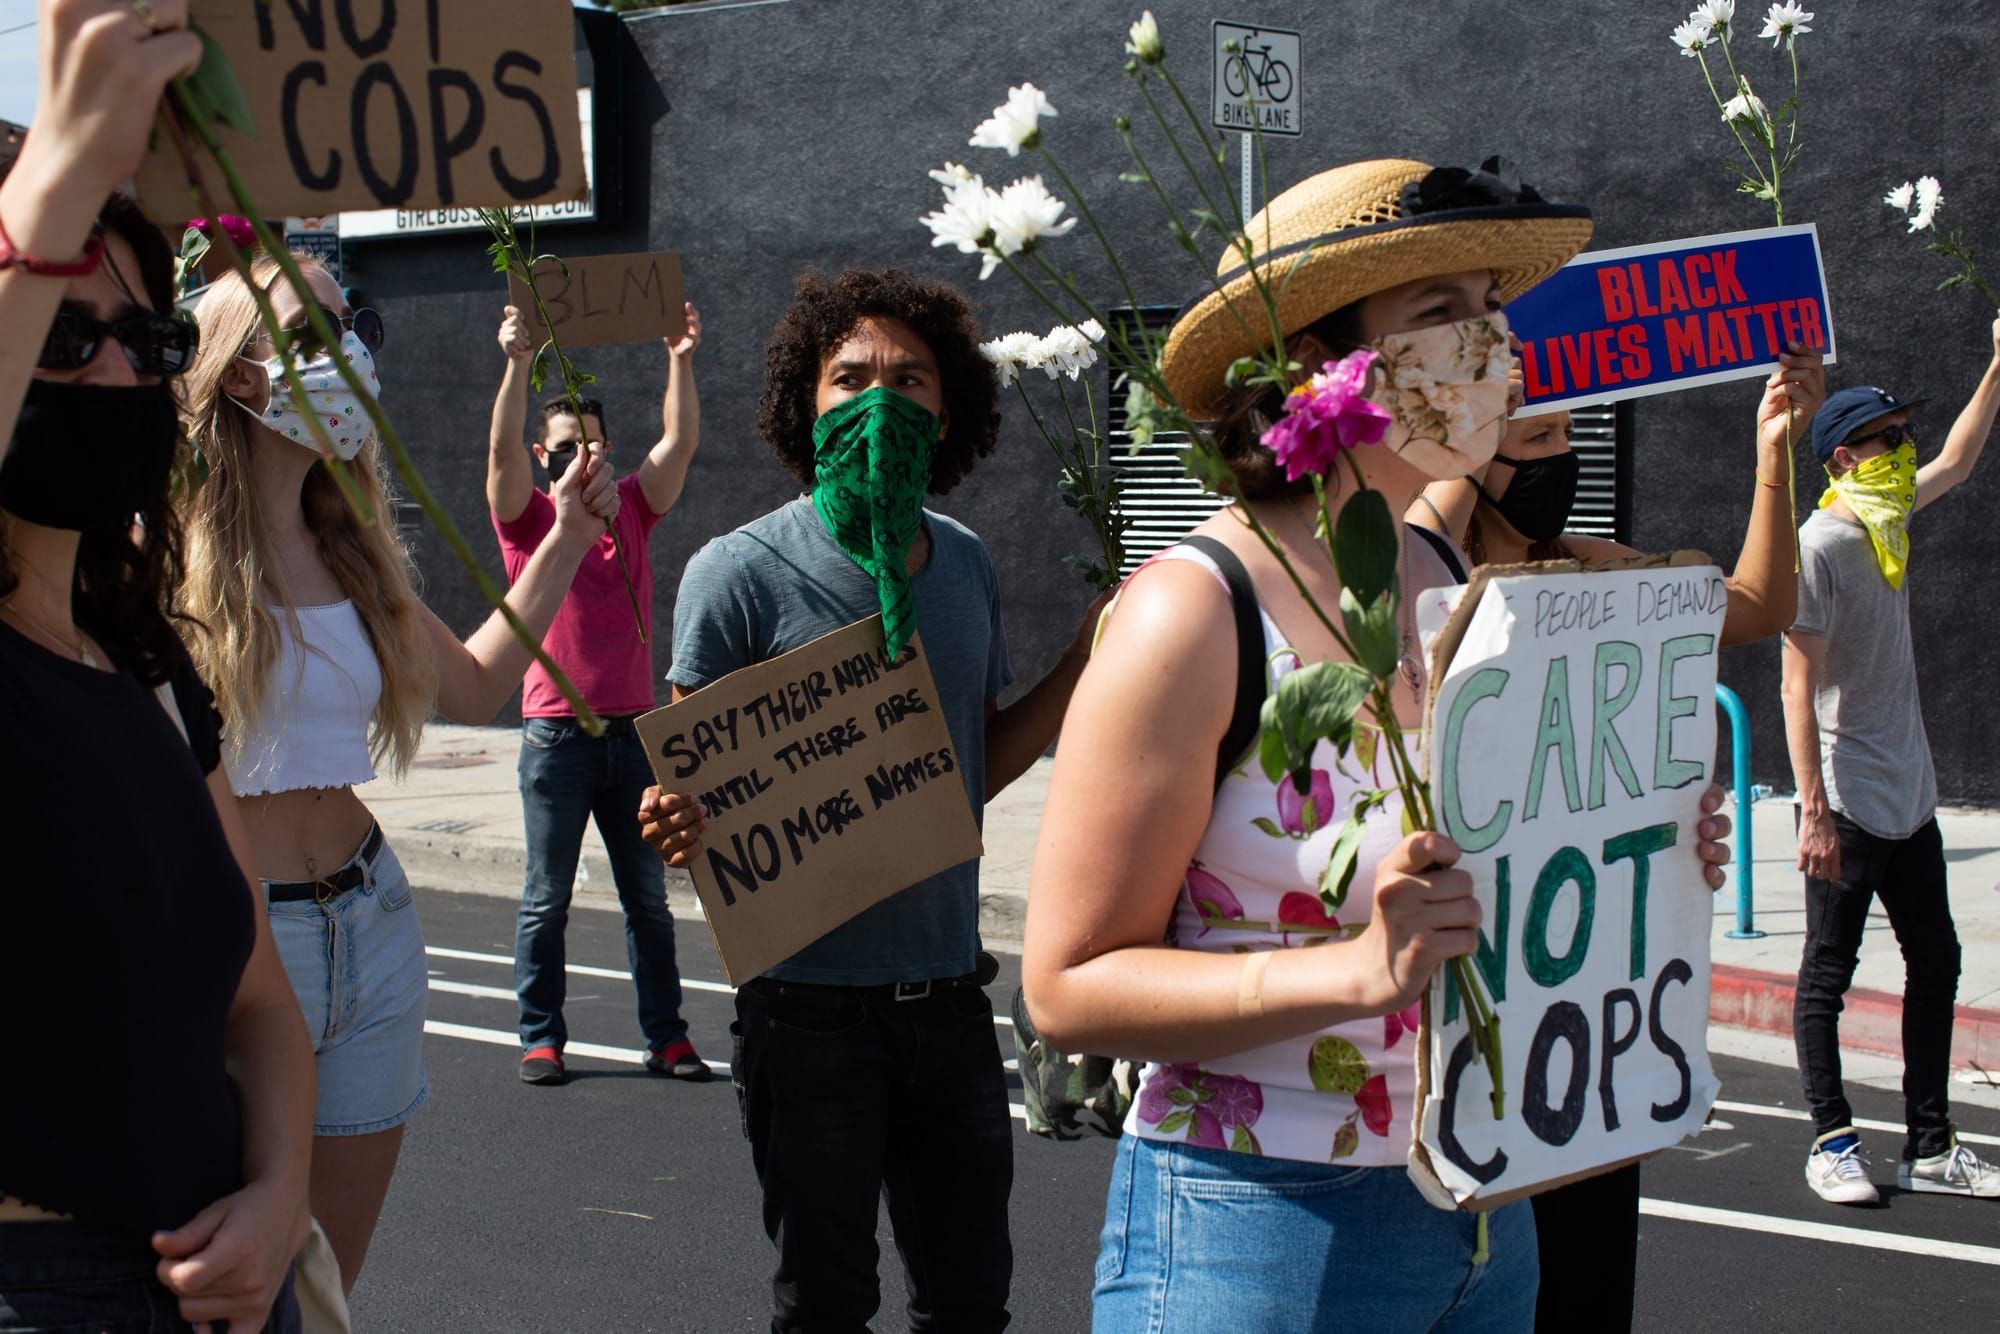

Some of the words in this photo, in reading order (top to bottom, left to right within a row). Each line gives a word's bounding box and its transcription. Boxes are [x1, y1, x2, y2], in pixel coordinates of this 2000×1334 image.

[281, 50, 561, 206] COPS
[1223, 103, 1251, 125] BIKE
[1257, 107, 1291, 129] LANE
[534, 259, 666, 328] BLM
[1596, 249, 1748, 323] BLACK
[1521, 325, 1652, 398] LIVES
[1663, 297, 1825, 373] MATTER
[1535, 590, 1616, 638] PEOPLE
[1637, 577, 1728, 626] DEMAND
[661, 708, 737, 779] SAY
[744, 671, 832, 738] THEIR
[774, 717, 866, 774] THERE
[875, 687, 930, 732] ARE
[1442, 634, 1715, 854] CARE
[706, 824, 782, 906] NO
[782, 789, 864, 865] MORE
[864, 747, 955, 810] NAMES
[1443, 822, 1677, 1026] NOT
[1438, 958, 1693, 1185] COPS
